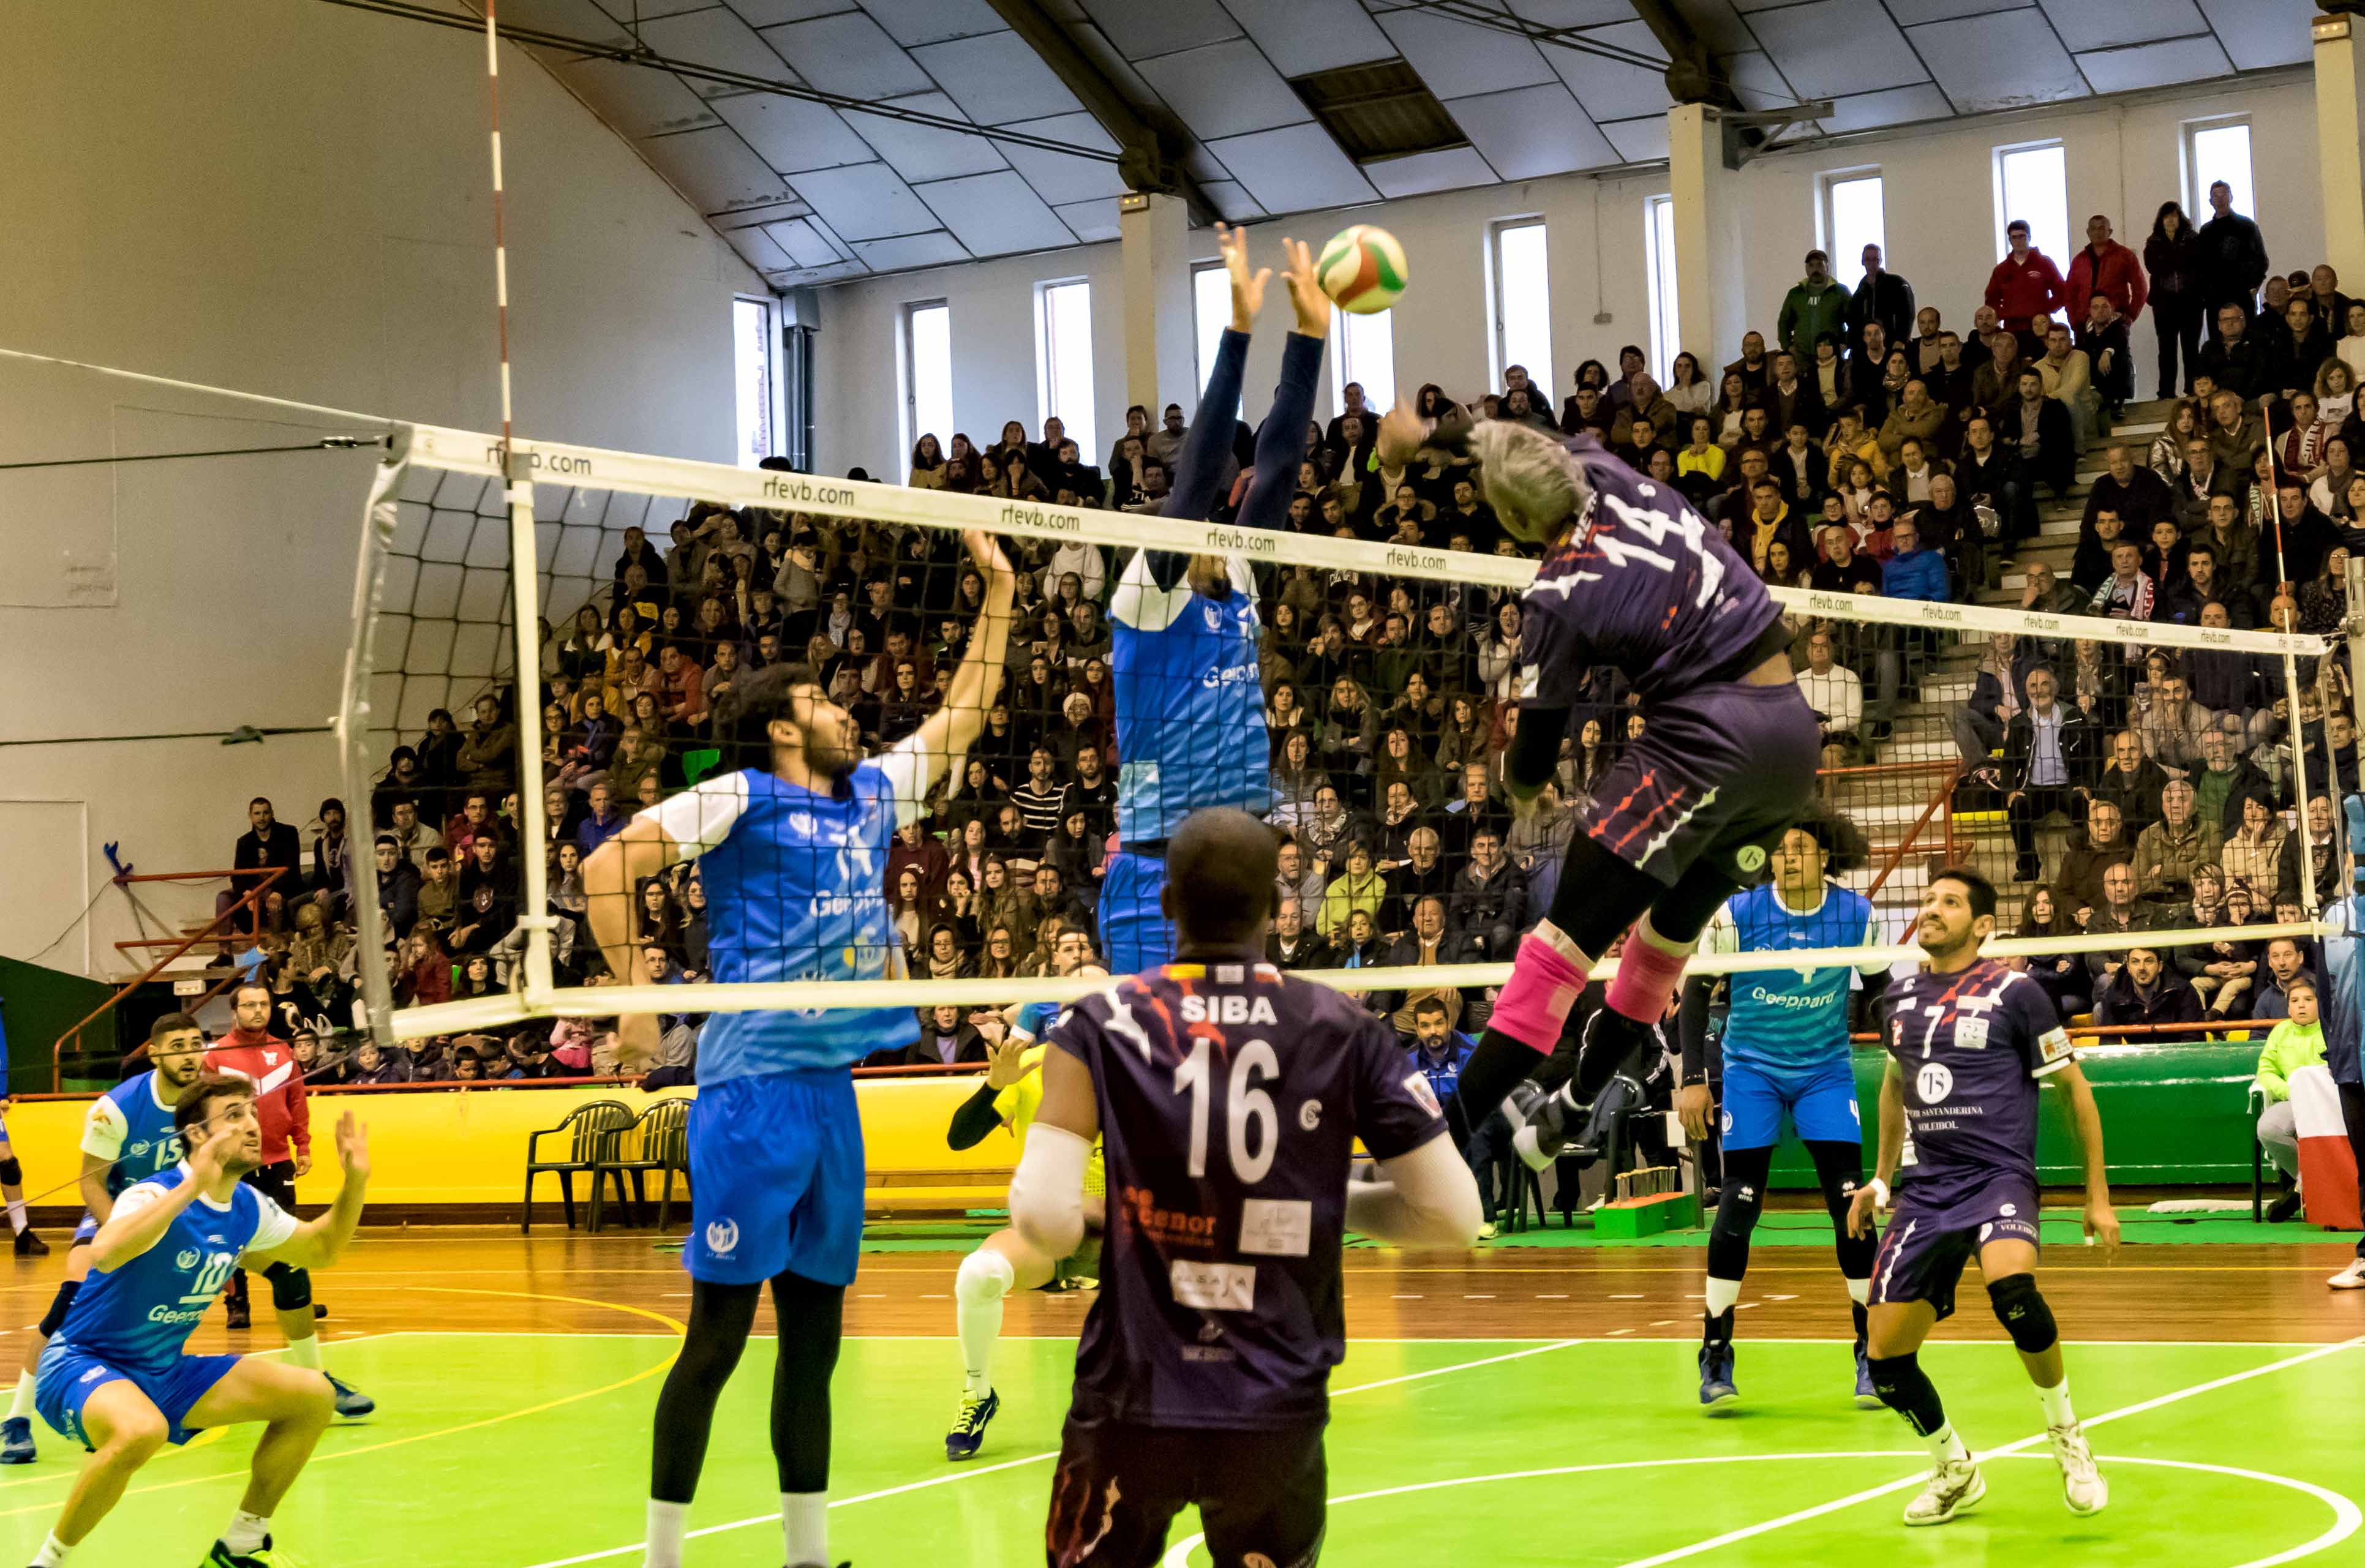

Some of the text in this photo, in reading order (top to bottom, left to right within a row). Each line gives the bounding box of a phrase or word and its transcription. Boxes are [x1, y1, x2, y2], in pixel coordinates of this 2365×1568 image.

[764, 476, 855, 506] rfevb.com
[1002, 504, 1080, 530] rfevb.com
[1206, 527, 1275, 552] rfevb.com
[1386, 548, 1447, 570] rfevb.com
[1809, 593, 1853, 612] rfevb.com
[1922, 604, 1963, 622] rfevb.com
[2024, 613, 2059, 632] rfevb.com
[2116, 621, 2149, 637] rfevb.com
[1180, 994, 1279, 1025] SIBA
[1752, 986, 1837, 1010] Geeppard
[1922, 1005, 1946, 1059] 7
[1173, 1037, 1280, 1185] 16
[154, 1138, 184, 1171] 15
[191, 1251, 233, 1294] 10
